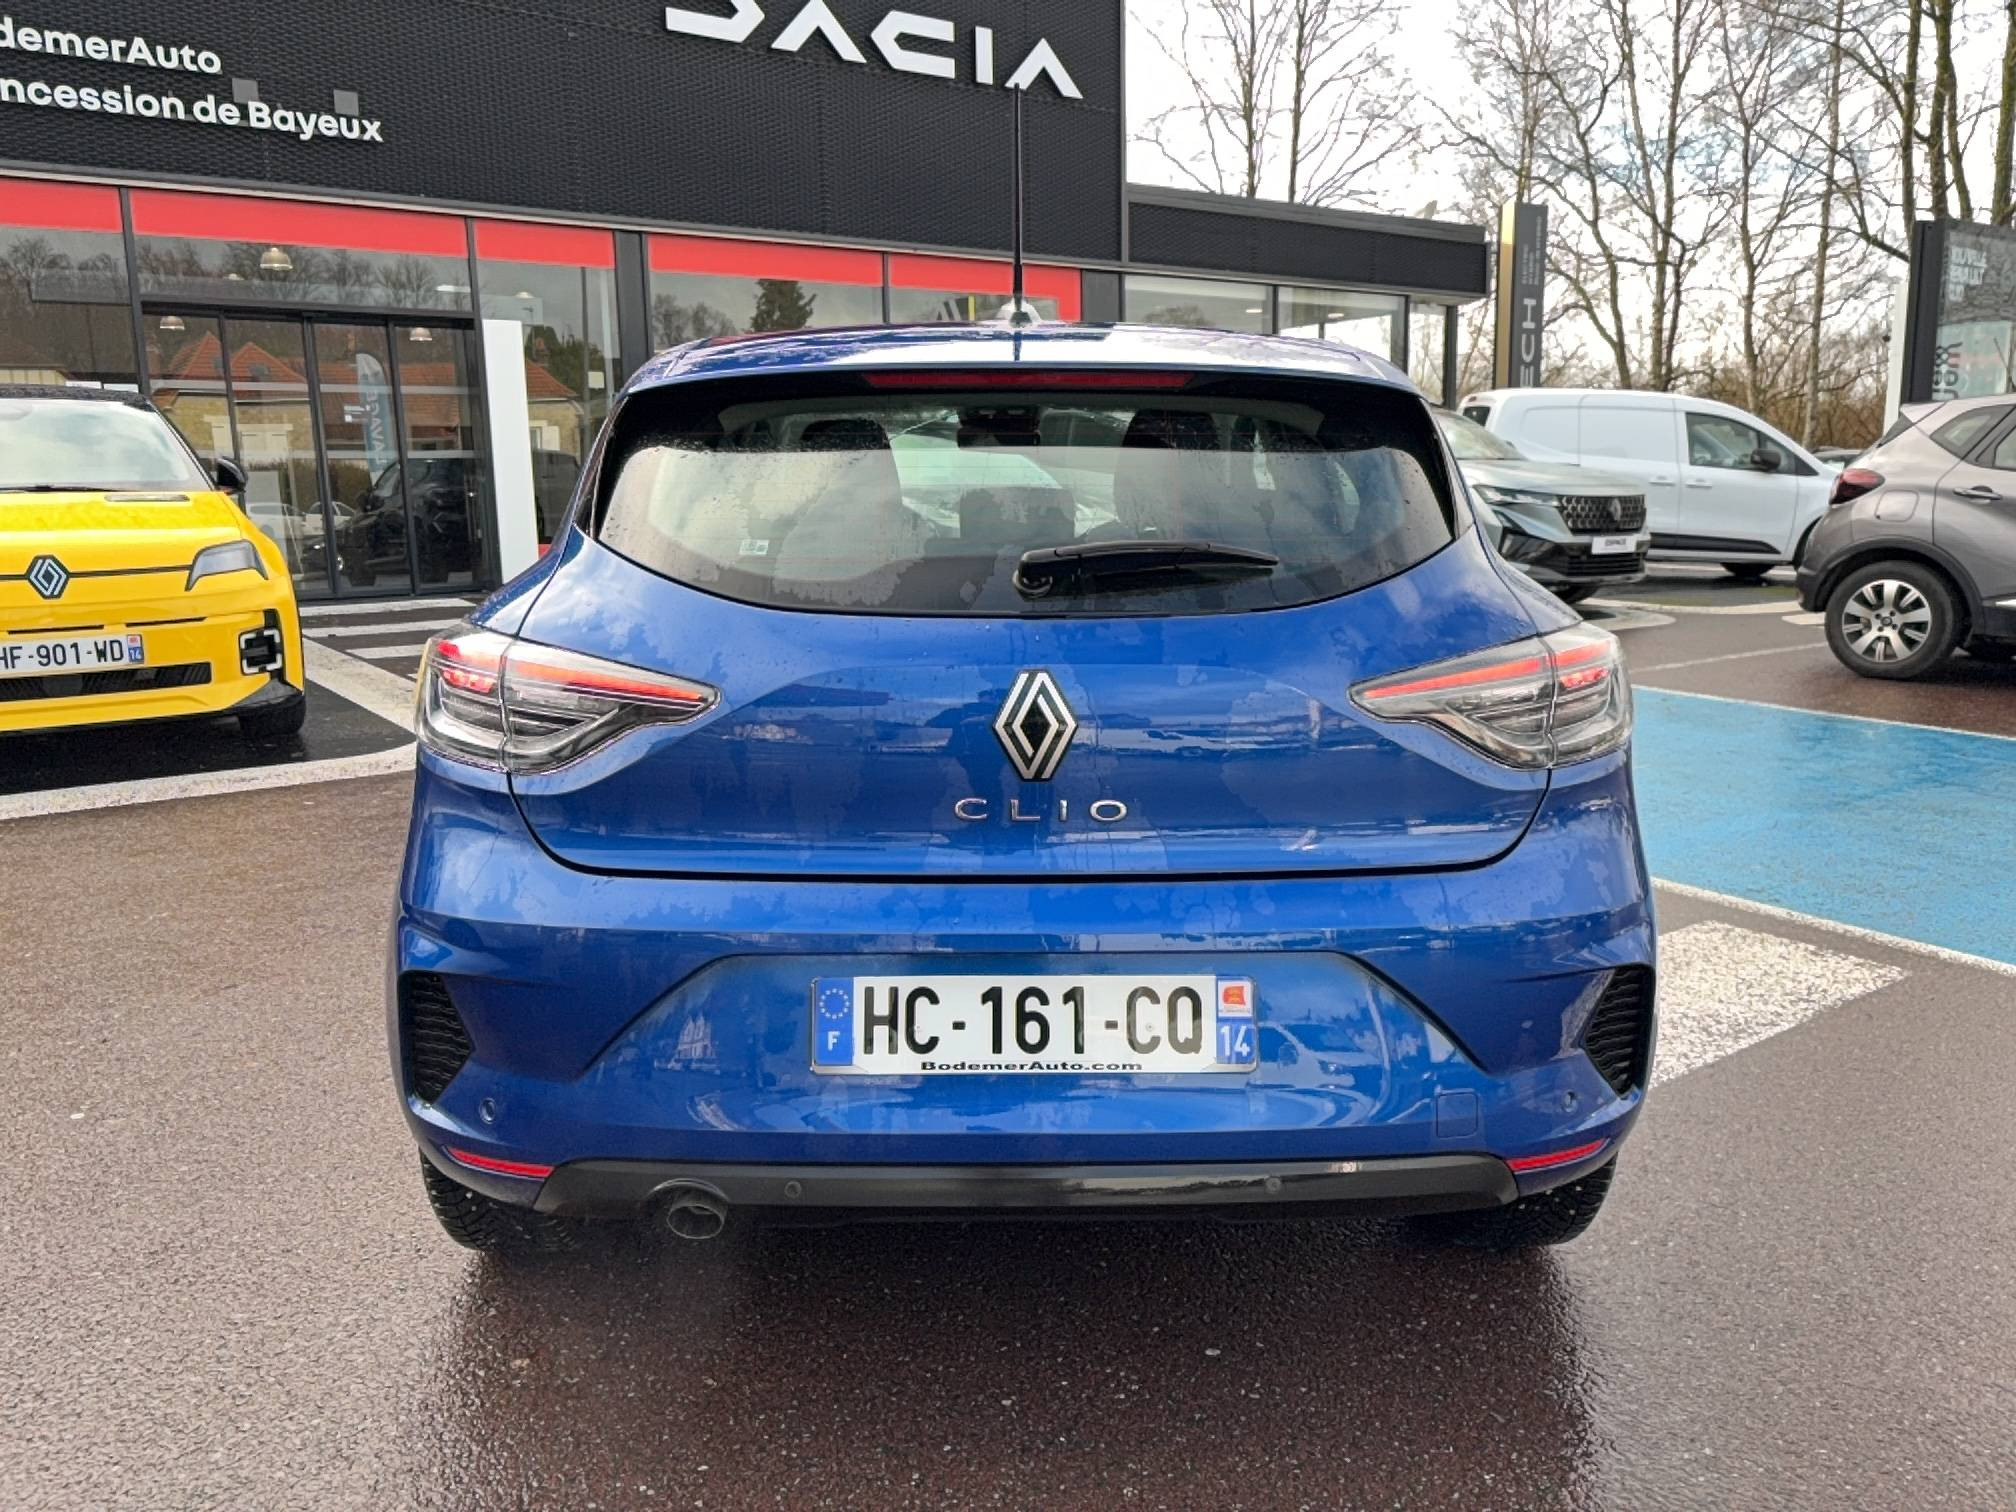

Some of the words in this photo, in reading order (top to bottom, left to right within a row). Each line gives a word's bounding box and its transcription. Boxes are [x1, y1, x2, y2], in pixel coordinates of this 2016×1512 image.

[193, 94, 241, 126] de
[248, 100, 384, 142] Bayeux
[954, 797, 1128, 822] CLIO
[863, 986, 1202, 1055] HC-161-CQ
[827, 1030, 840, 1052] F
[1219, 1024, 1251, 1058] 14
[920, 1060, 1143, 1072] BodemerAuto.com
